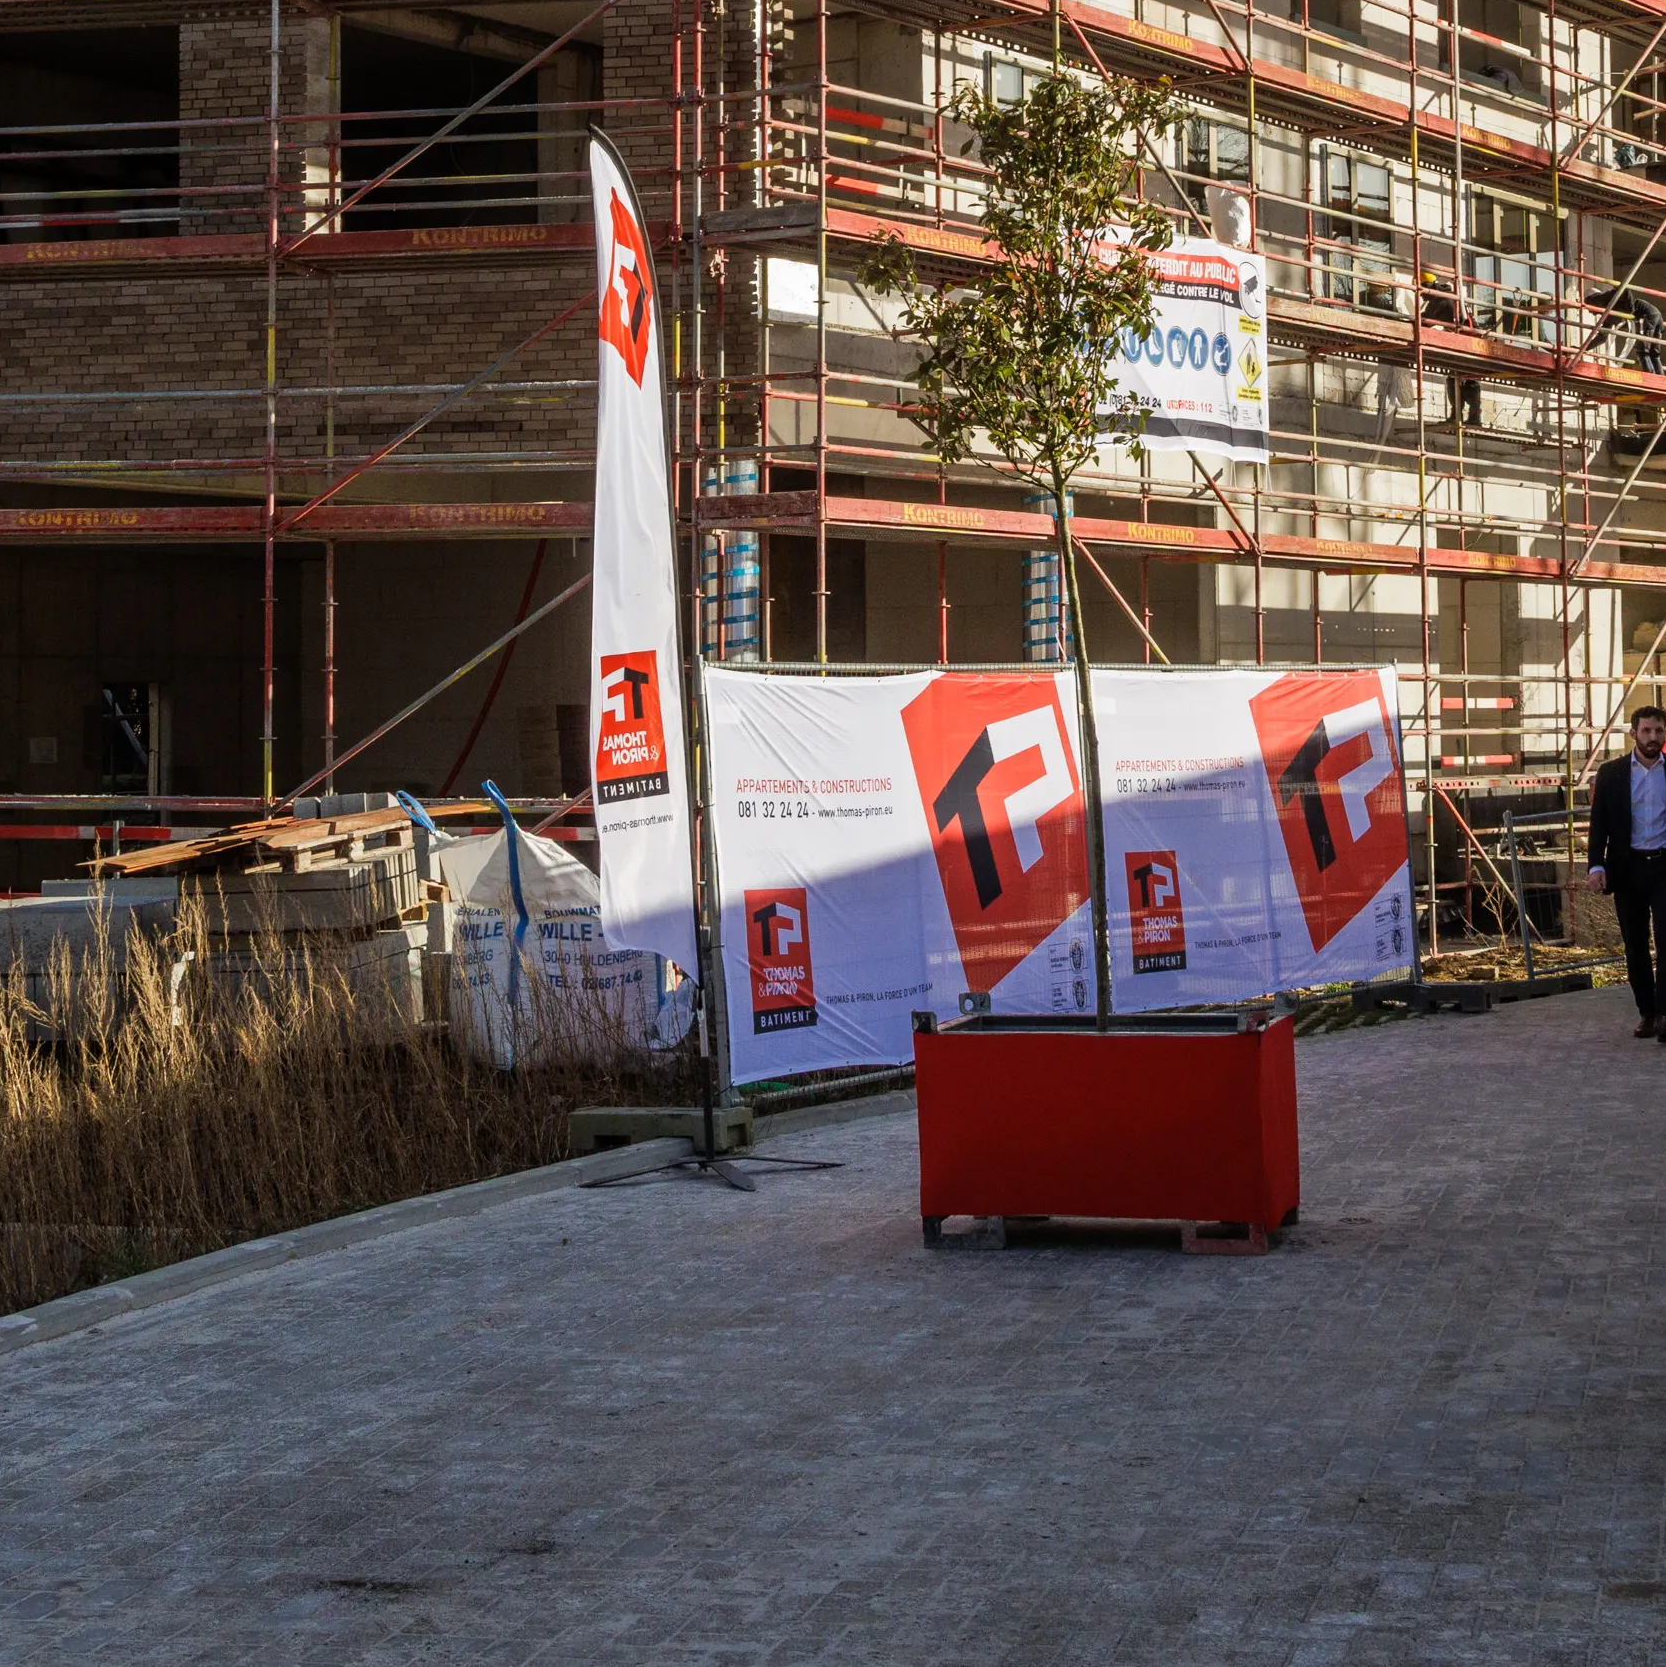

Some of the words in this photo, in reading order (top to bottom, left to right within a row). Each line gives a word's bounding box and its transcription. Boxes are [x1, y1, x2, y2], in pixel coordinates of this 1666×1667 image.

[1127, 19, 1193, 51] KONTRIMO
[1461, 123, 1511, 149] KONTRIMO
[413, 225, 545, 246] KONTRIMO
[905, 225, 988, 255] KONTRIMO
[1190, 260, 1203, 279] AU
[1205, 262, 1236, 284] PUBLIC
[1177, 284, 1208, 298] CONTRE
[1209, 287, 1219, 299] LE
[1220, 289, 1235, 304] VOL
[1140, 396, 1150, 407] 24
[1151, 397, 1162, 408] 24
[1200, 402, 1213, 413] 112
[903, 504, 985, 527] KONTRIMO
[1128, 524, 1194, 543] KONTRIMO
[1116, 760, 1176, 772] APPARTEMENTS
[1185, 756, 1244, 771] CONSTRUCTIONS
[736, 779, 810, 794] APPARTEMENTS
[811, 780, 818, 794] &
[820, 777, 892, 793] CONSTRUCTIONS
[1117, 778, 1133, 793] 081
[1137, 778, 1148, 792] 32
[1152, 778, 1162, 792] 24
[1166, 778, 1176, 792] 24
[738, 801, 757, 818] 081
[762, 801, 775, 818] 32
[780, 801, 792, 818] 24
[797, 801, 809, 818] 24
[818, 805, 893, 819] www.thomas-piron.eu
[1143, 916, 1178, 930] THOMAS
[538, 923, 593, 942] WILLE
[1144, 930, 1171, 943] PIRON
[1195, 940, 1214, 949] THOMAS
[1139, 955, 1182, 970] BATIMENT
[763, 965, 805, 982] THOMAS
[758, 982, 766, 998] &
[826, 995, 849, 1005] THOMAS
[885, 990, 903, 1000] FORCE
[918, 983, 933, 995] TEAM
[760, 1010, 812, 1028] BATIMENT
